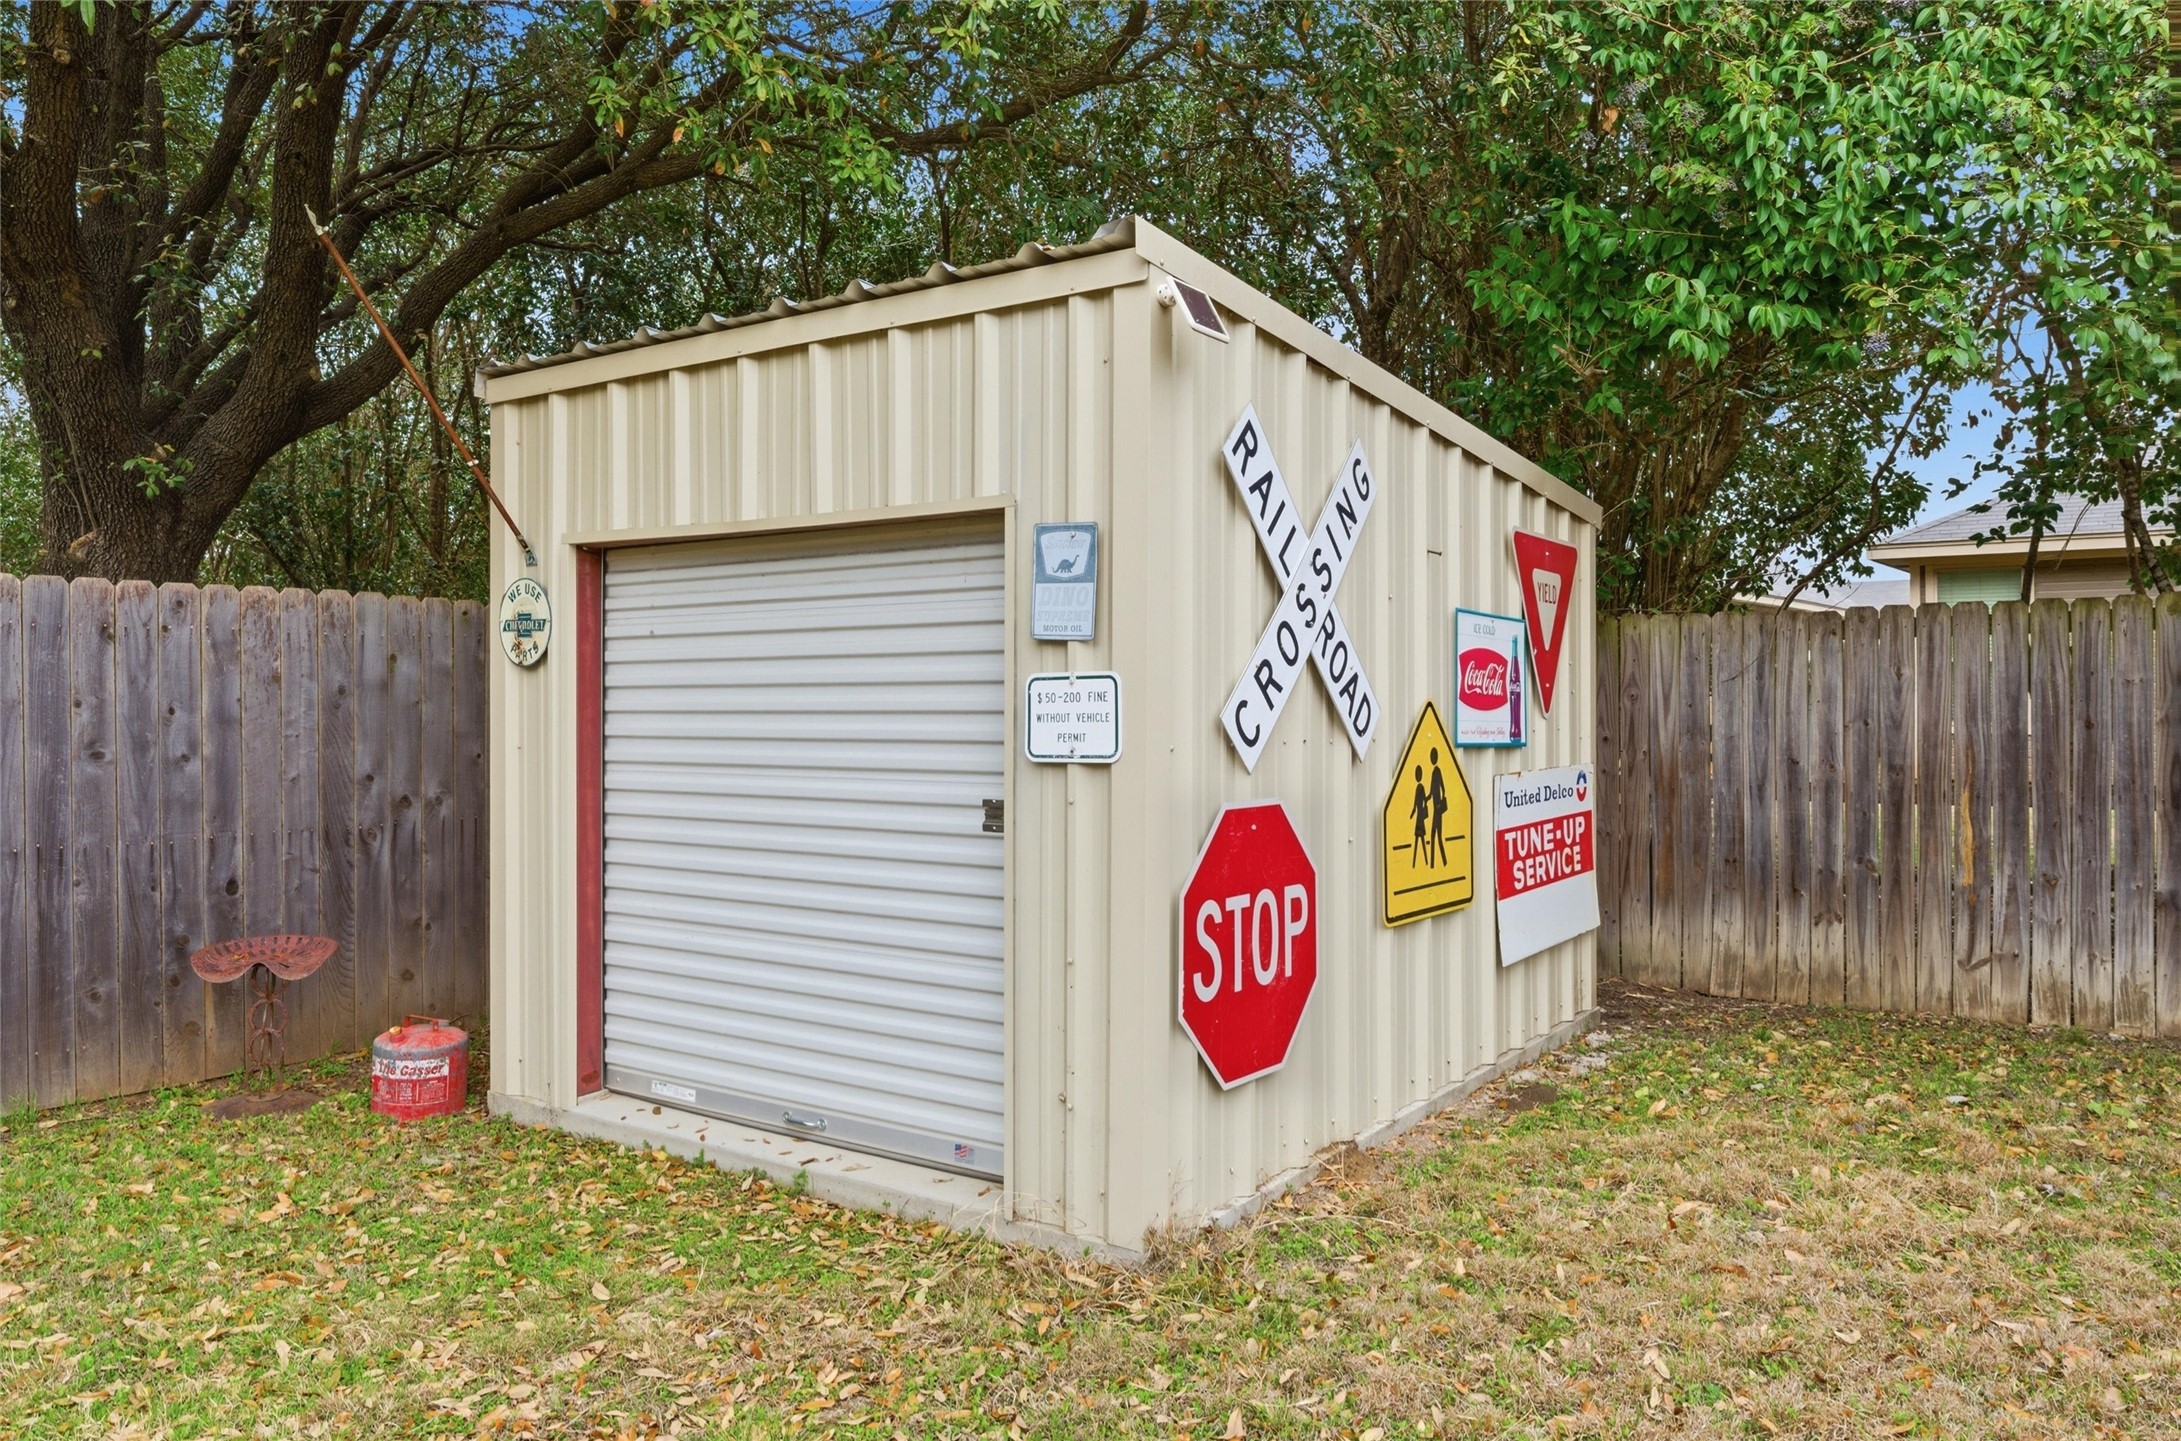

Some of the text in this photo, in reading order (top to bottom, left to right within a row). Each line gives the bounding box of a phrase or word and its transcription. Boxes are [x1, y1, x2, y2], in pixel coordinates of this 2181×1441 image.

[1232, 419, 1296, 578] RAIL
[508, 583, 542, 603] WE USE
[1039, 586, 1090, 607] DINO
[1235, 458, 1370, 748] CROSSING
[1537, 582, 1557, 605] YIELD
[505, 620, 544, 632] CHEVROLET
[1036, 610, 1091, 622] SUPREME
[1043, 624, 1083, 632] MOTOR OIL
[1473, 623, 1496, 636] ICE COLD
[510, 640, 539, 662] PARTS
[1315, 609, 1371, 738] ROAD
[1464, 660, 1505, 696] Coca-Cola
[1088, 691, 1108, 703] FINE
[1036, 712, 1110, 723] WITHOUT VEHICLE
[1057, 733, 1086, 743] PERMIT
[1504, 784, 1574, 808] United Delco
[1504, 816, 1585, 861] TUNE-UP
[1513, 845, 1582, 890] SERVICE
[1193, 883, 1309, 1002] STOP
[400, 1064, 445, 1077] Gasser
